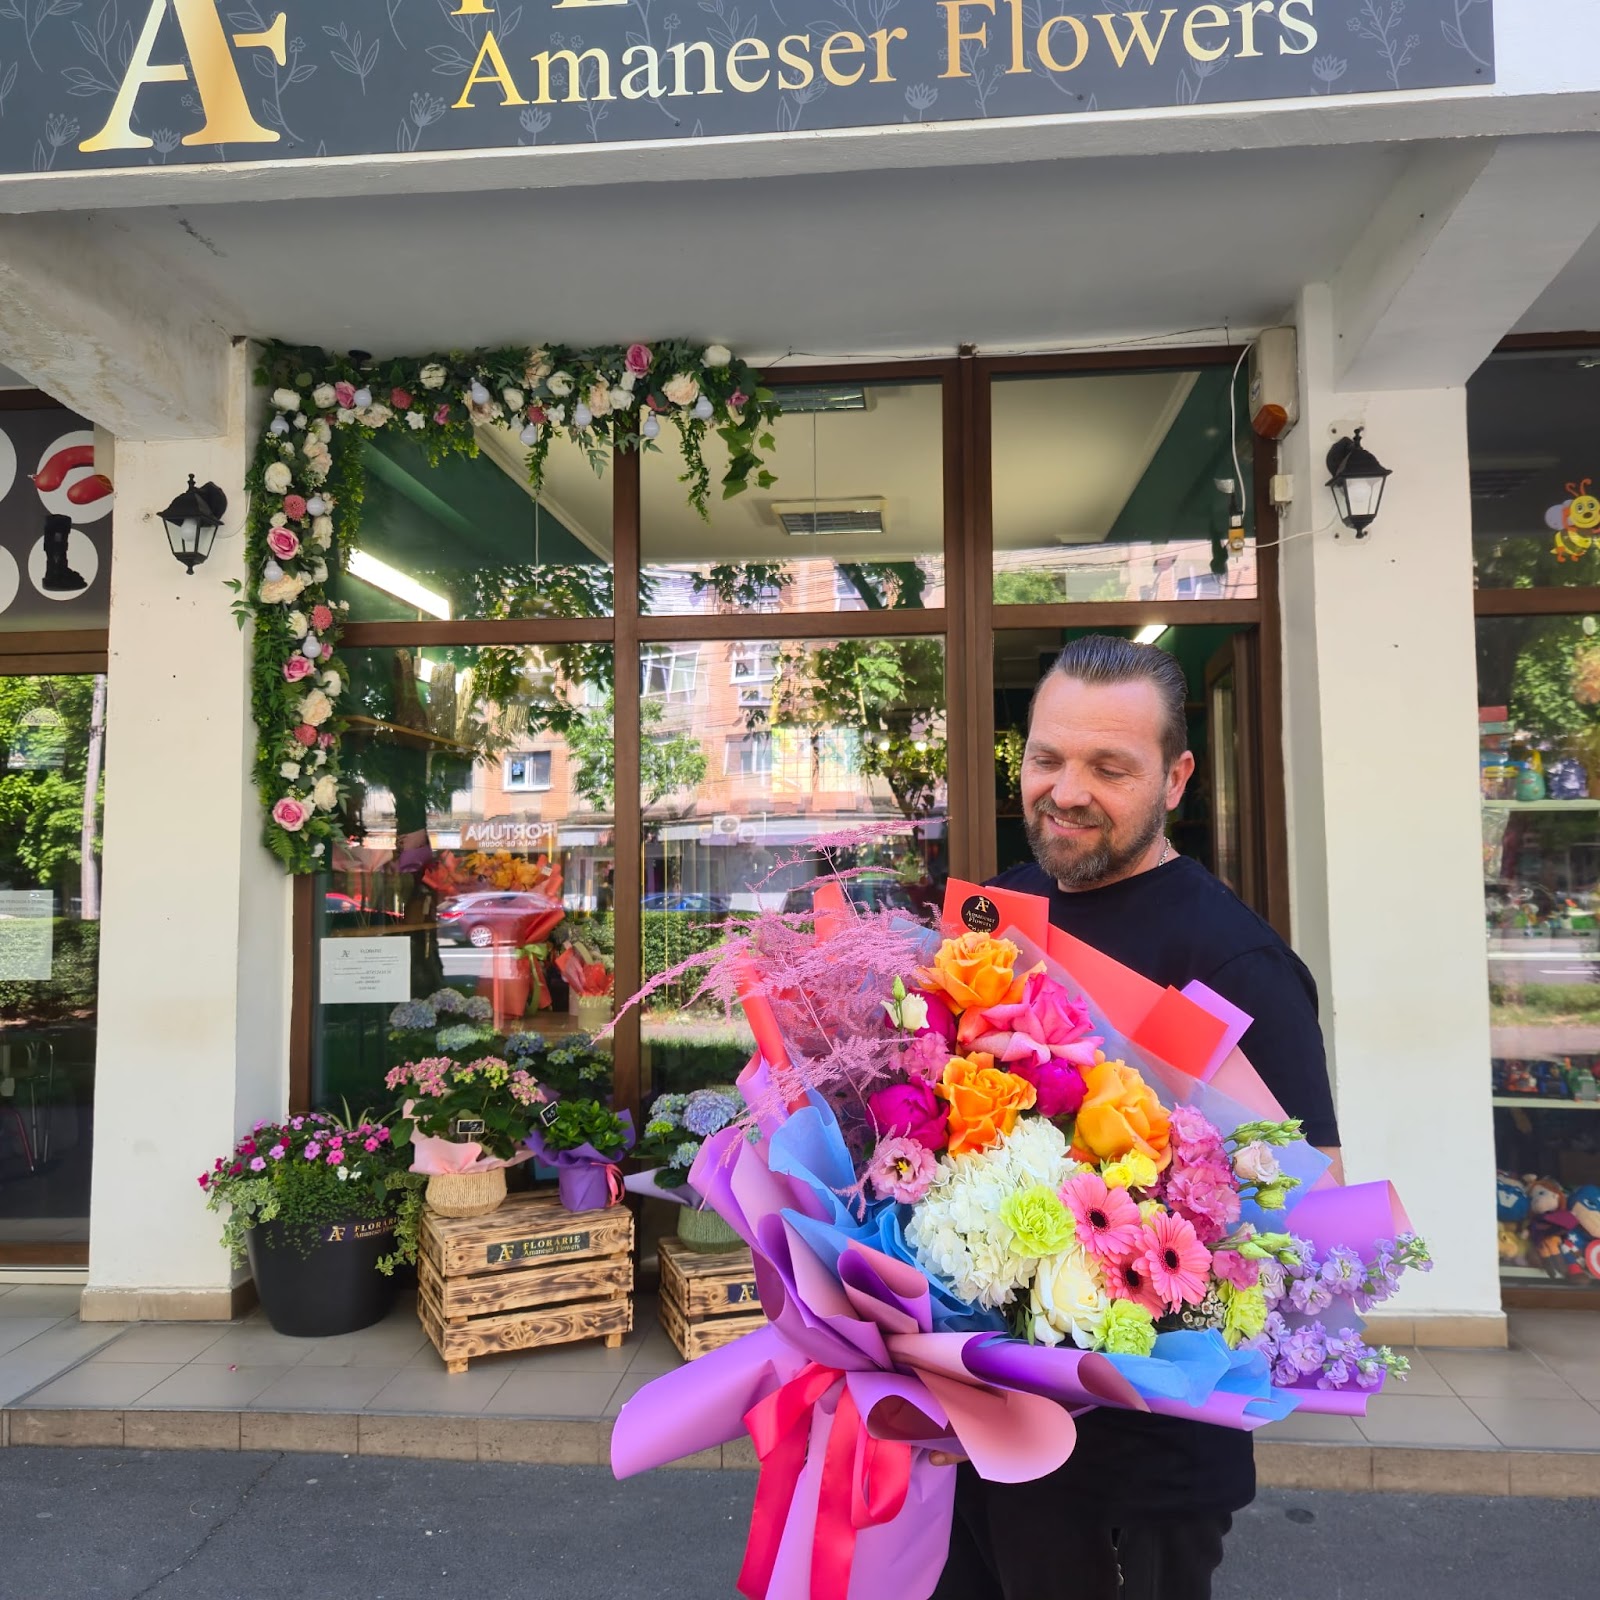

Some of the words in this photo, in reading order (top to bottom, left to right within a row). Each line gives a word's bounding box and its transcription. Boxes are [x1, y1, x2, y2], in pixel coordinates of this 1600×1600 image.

[451, 27, 907, 109] Amaneser
[937, 0, 1319, 79] Flowers
[355, 1217, 398, 1232] FLORARI
[523, 1235, 581, 1250] FLORARIE
